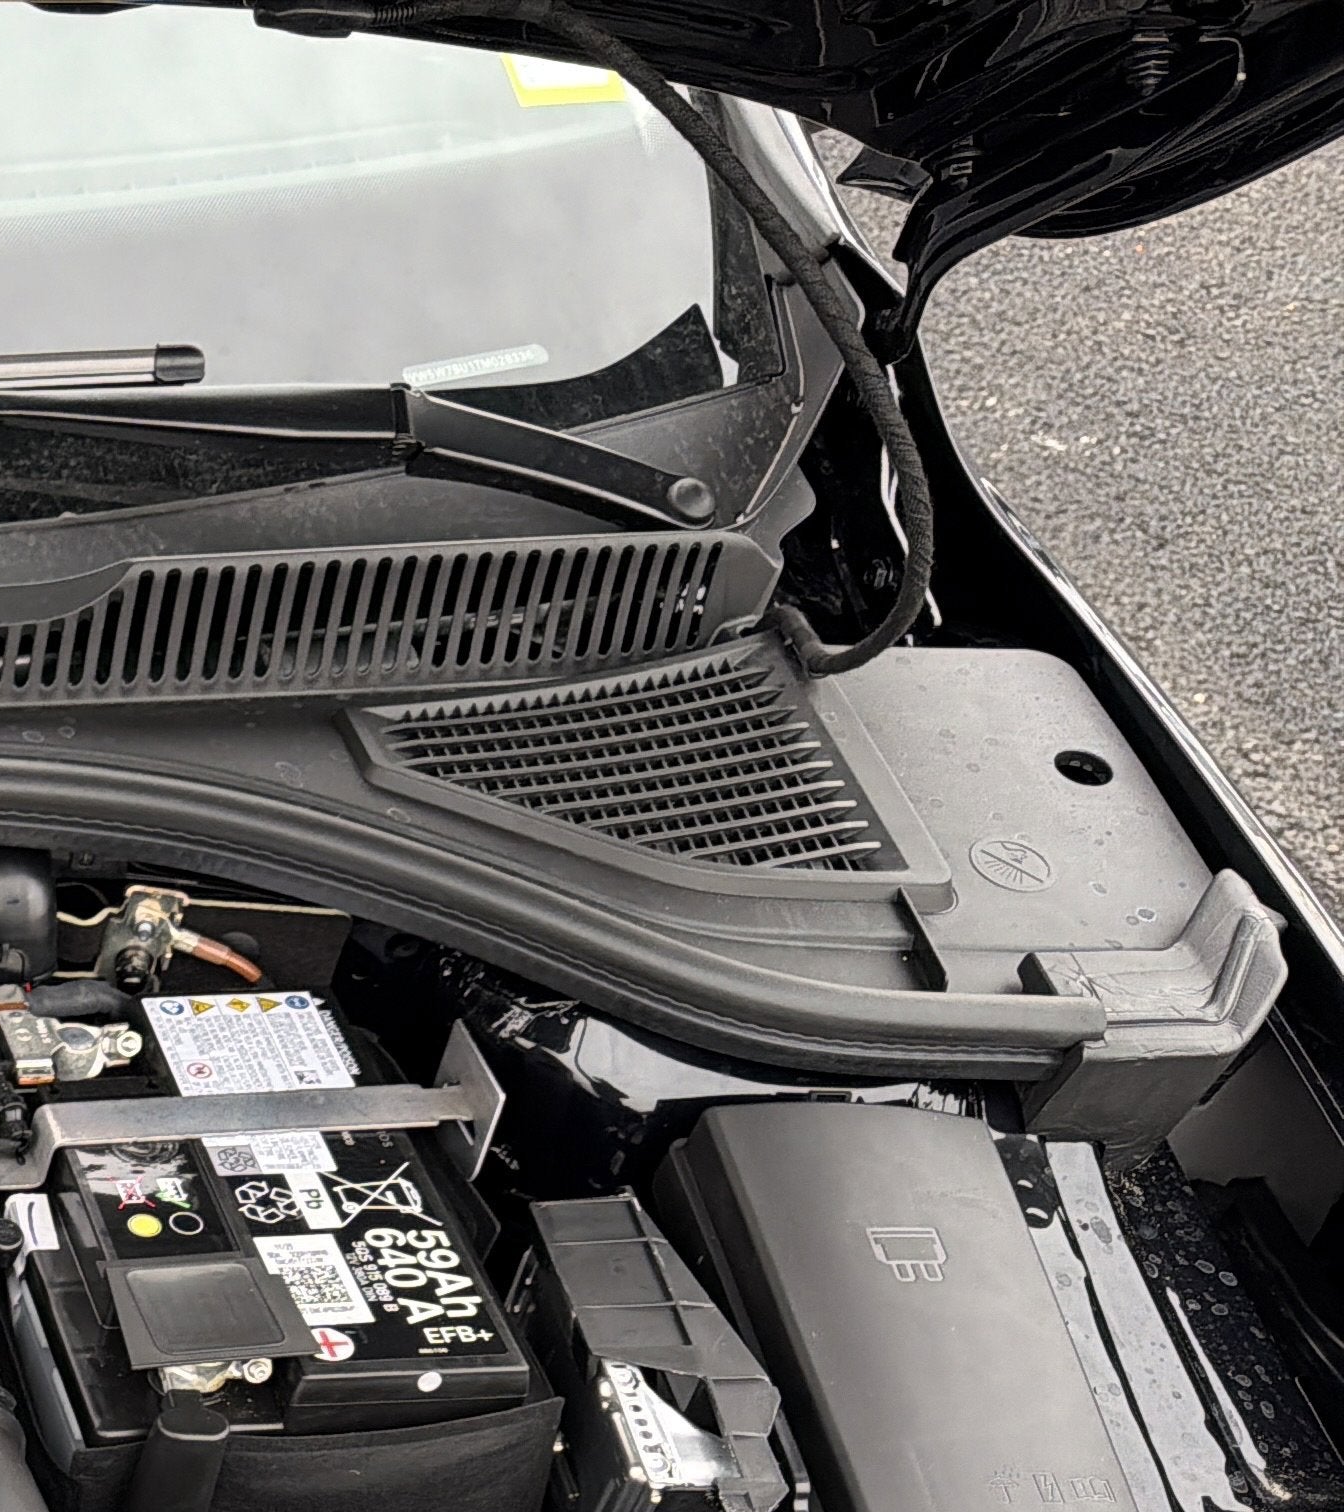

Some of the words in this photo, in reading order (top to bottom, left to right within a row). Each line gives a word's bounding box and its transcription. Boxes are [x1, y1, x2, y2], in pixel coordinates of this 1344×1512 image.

[298, 1188, 322, 1210] Pb
[364, 1227, 429, 1289] 640
[397, 1297, 445, 1325] A
[406, 1229, 483, 1318] 59Ah
[423, 1325, 495, 1345] EFB+
